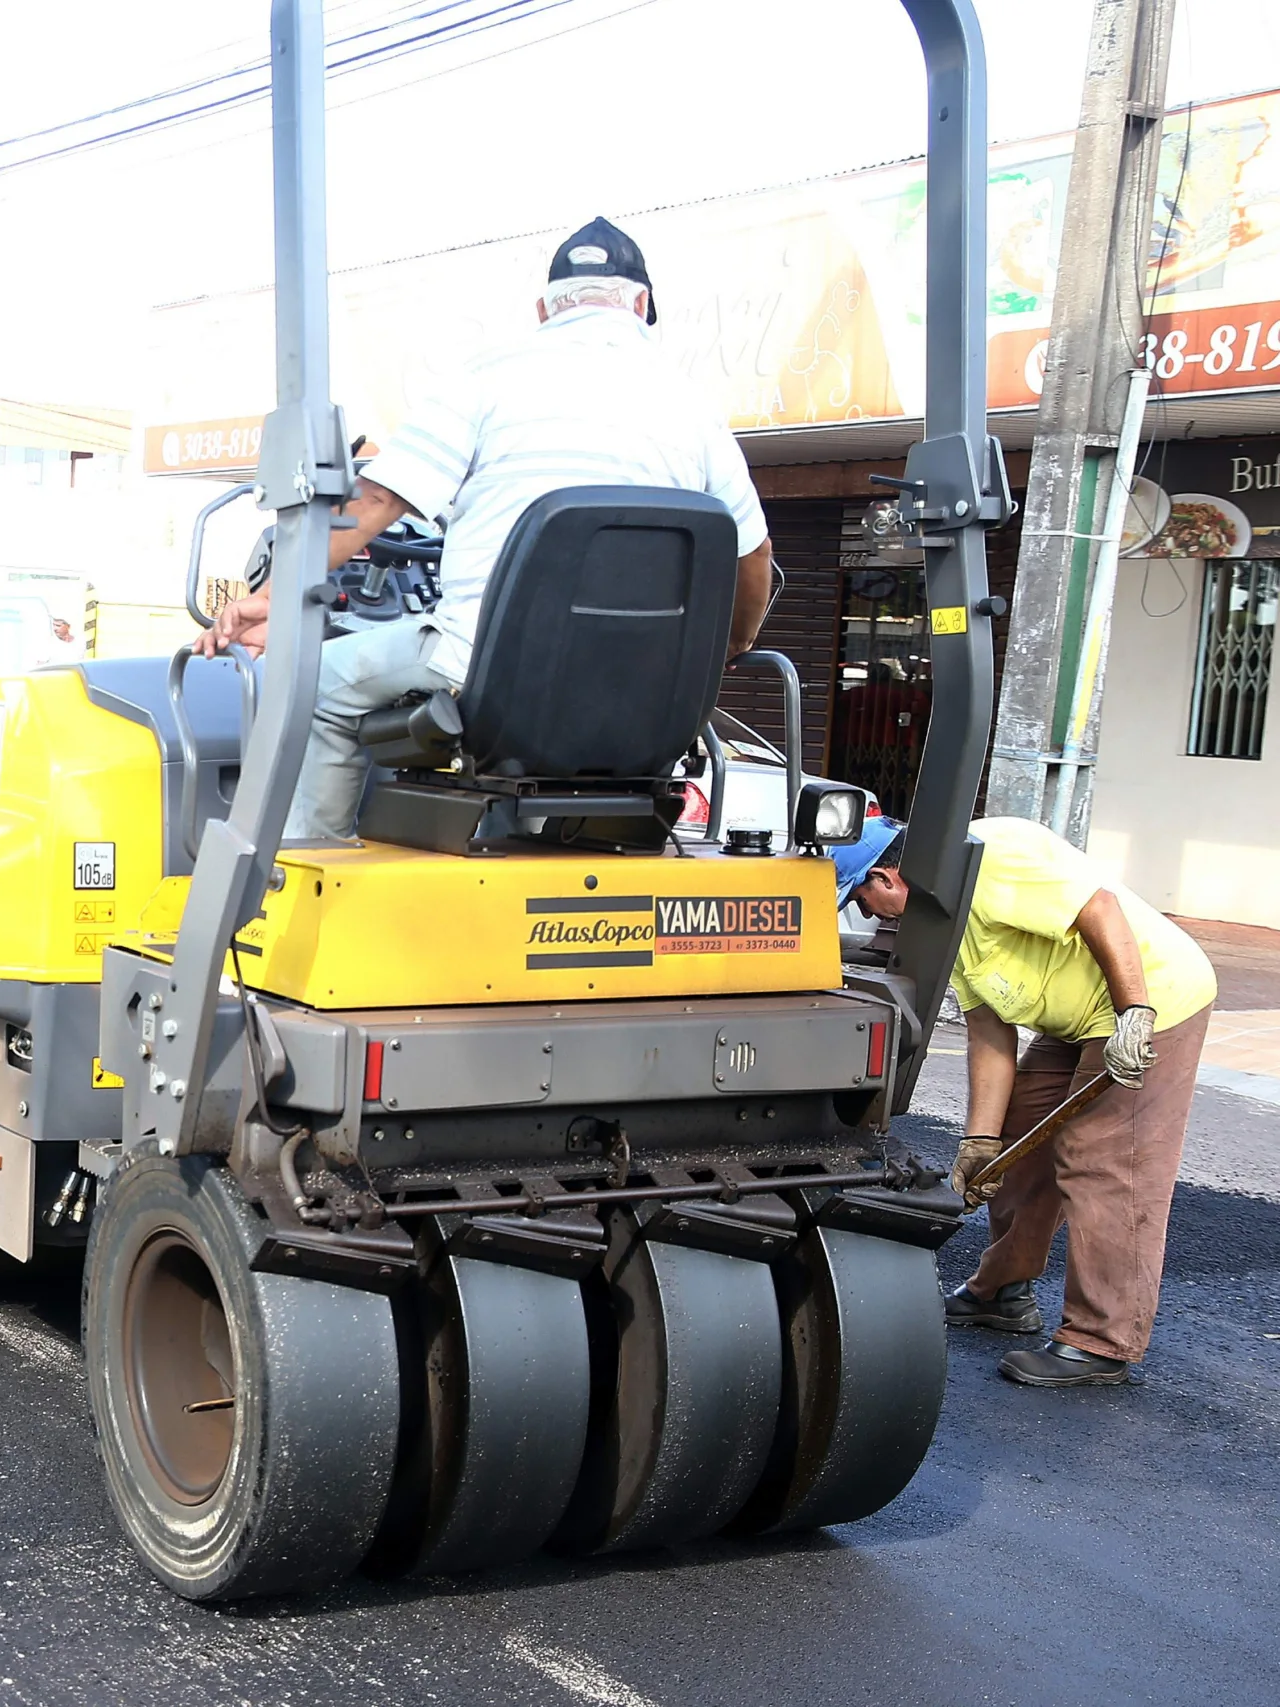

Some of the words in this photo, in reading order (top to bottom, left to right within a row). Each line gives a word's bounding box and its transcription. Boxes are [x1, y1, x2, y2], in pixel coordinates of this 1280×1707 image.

[78, 863, 100, 885] 105
[102, 873, 112, 885] dB
[671, 941, 722, 951] 3555-3723
[745, 940, 796, 950] 3373-0440
